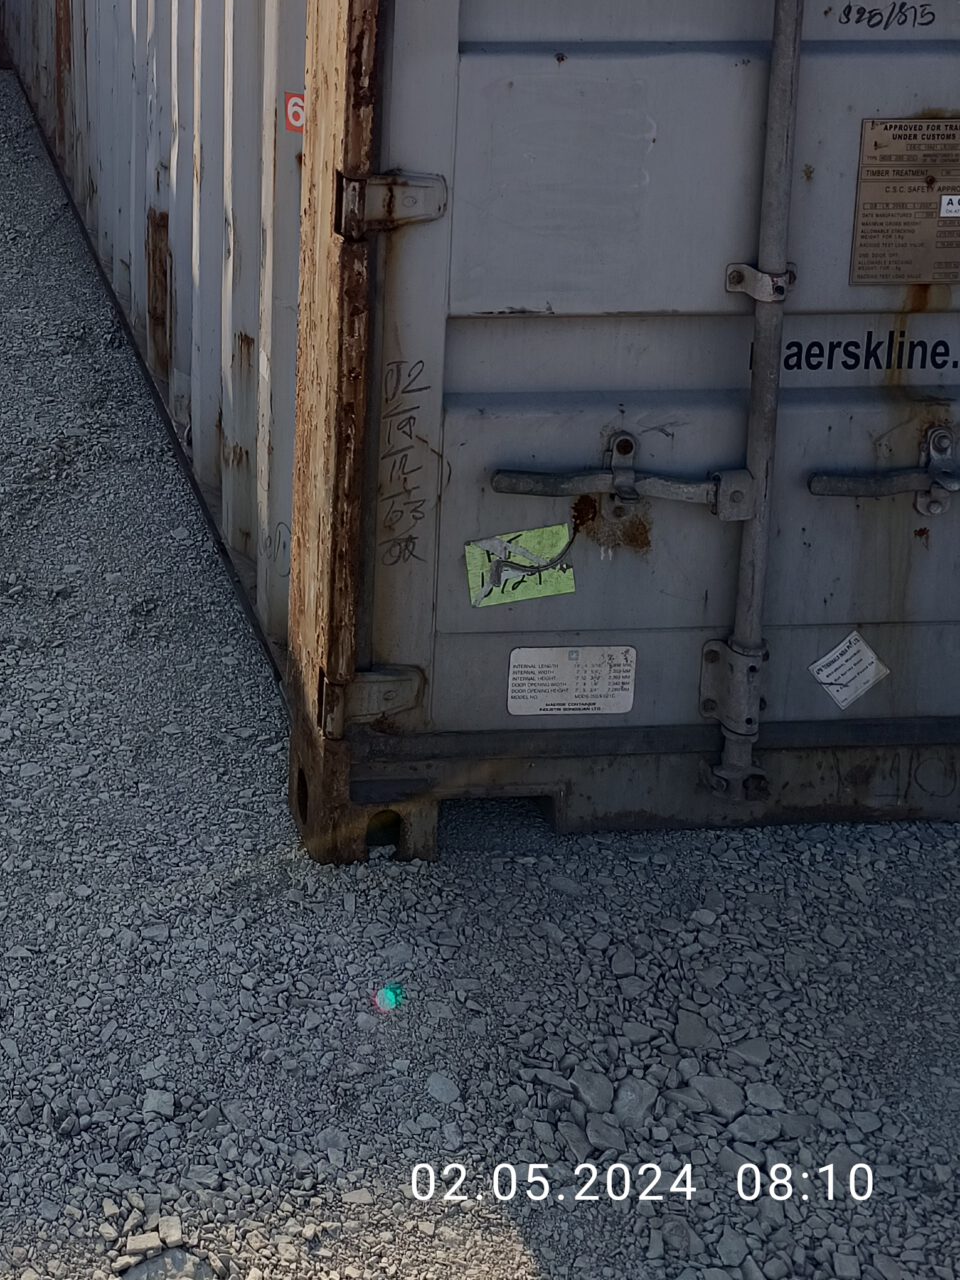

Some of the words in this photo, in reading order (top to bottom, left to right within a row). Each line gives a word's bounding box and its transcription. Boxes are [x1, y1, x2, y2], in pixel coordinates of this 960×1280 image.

[883, 124, 923, 132] APPROVED
[926, 124, 941, 132] FOR
[892, 133, 918, 141] UNDER
[921, 133, 957, 141] CUSTOMS
[866, 169, 890, 177] TIMBER
[892, 169, 929, 177] TREATMENT
[783, 330, 959, 371] aerskline.
